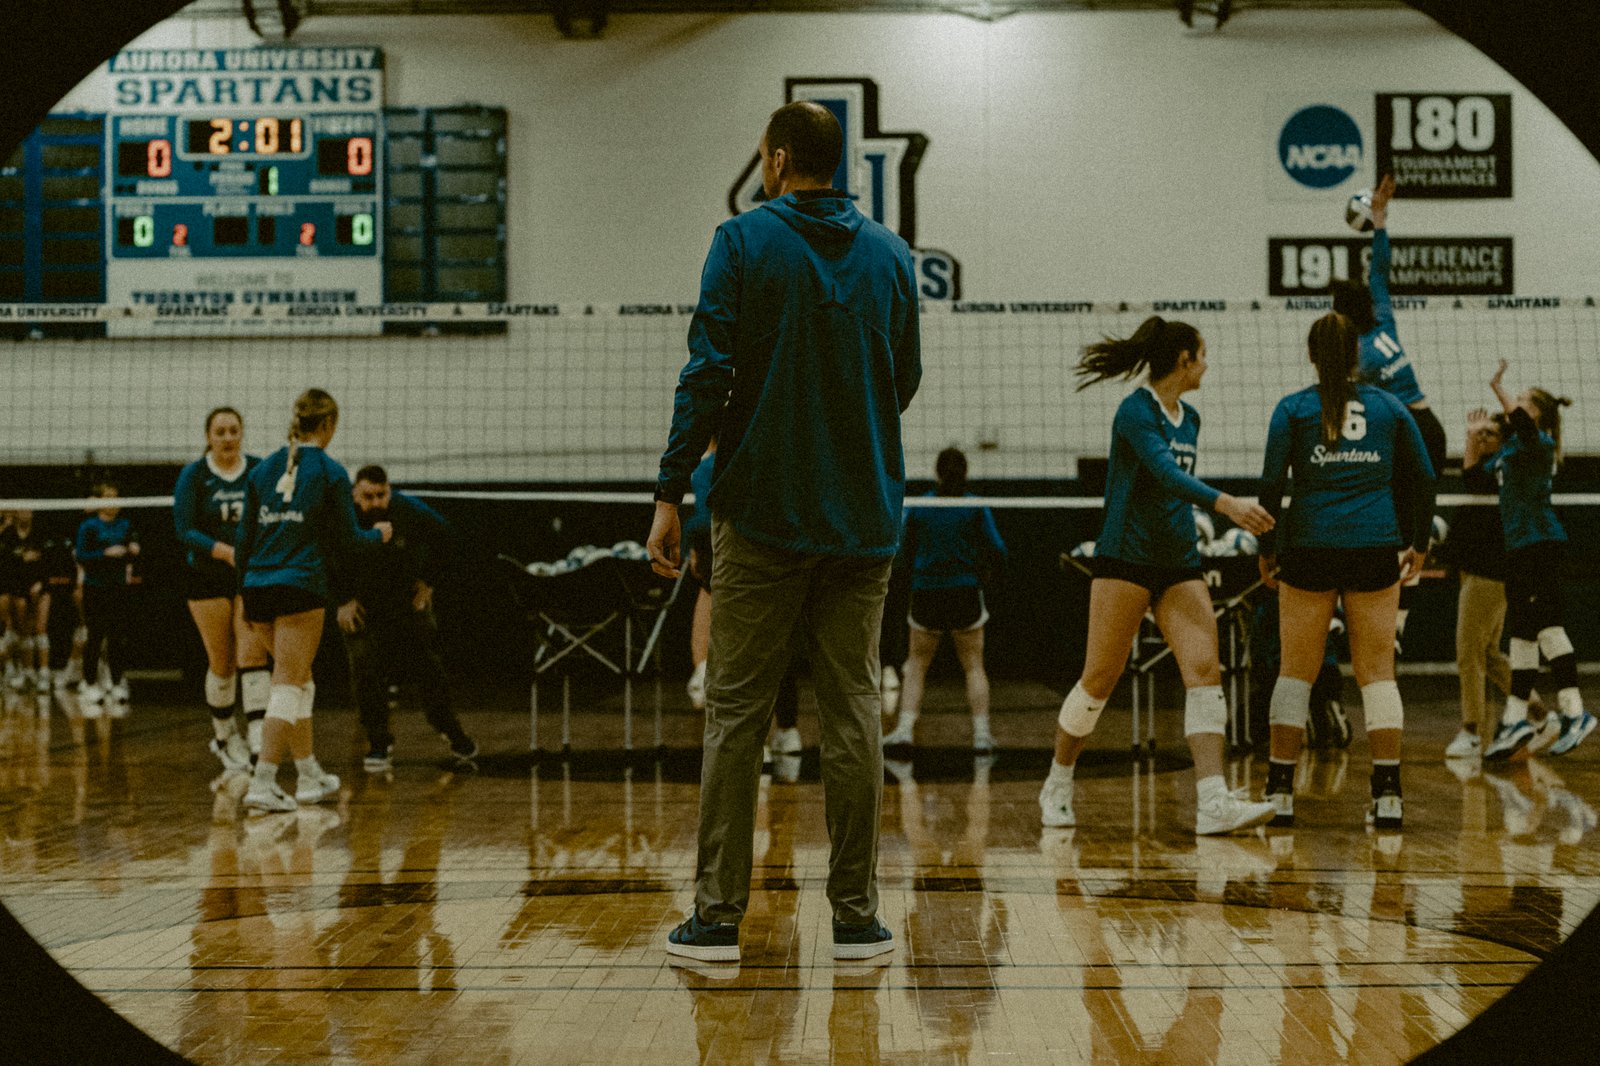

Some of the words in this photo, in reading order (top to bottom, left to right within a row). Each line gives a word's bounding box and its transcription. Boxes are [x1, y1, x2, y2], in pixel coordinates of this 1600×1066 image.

[114, 50, 217, 69] AURORA
[225, 49, 374, 69] UNIVERSITY
[117, 76, 373, 104] SPARTANS
[209, 118, 301, 155] 2:01
[1390, 95, 1496, 152] 180
[147, 139, 172, 178] 0
[347, 137, 373, 176] 0
[1286, 143, 1362, 169] NCAA
[1392, 154, 1496, 170] TOURNAMENT
[267, 165, 279, 196] 1
[133, 215, 154, 247] 0
[172, 223, 188, 247] 2
[299, 222, 316, 246] 2
[351, 213, 373, 246] 0
[1281, 244, 1349, 289] 191
[1360, 245, 1503, 268] CNFERENCE
[1373, 330, 1401, 359] 11
[1341, 400, 1367, 441] 6
[1310, 444, 1381, 467] Spartans
[275, 465, 298, 503] 4
